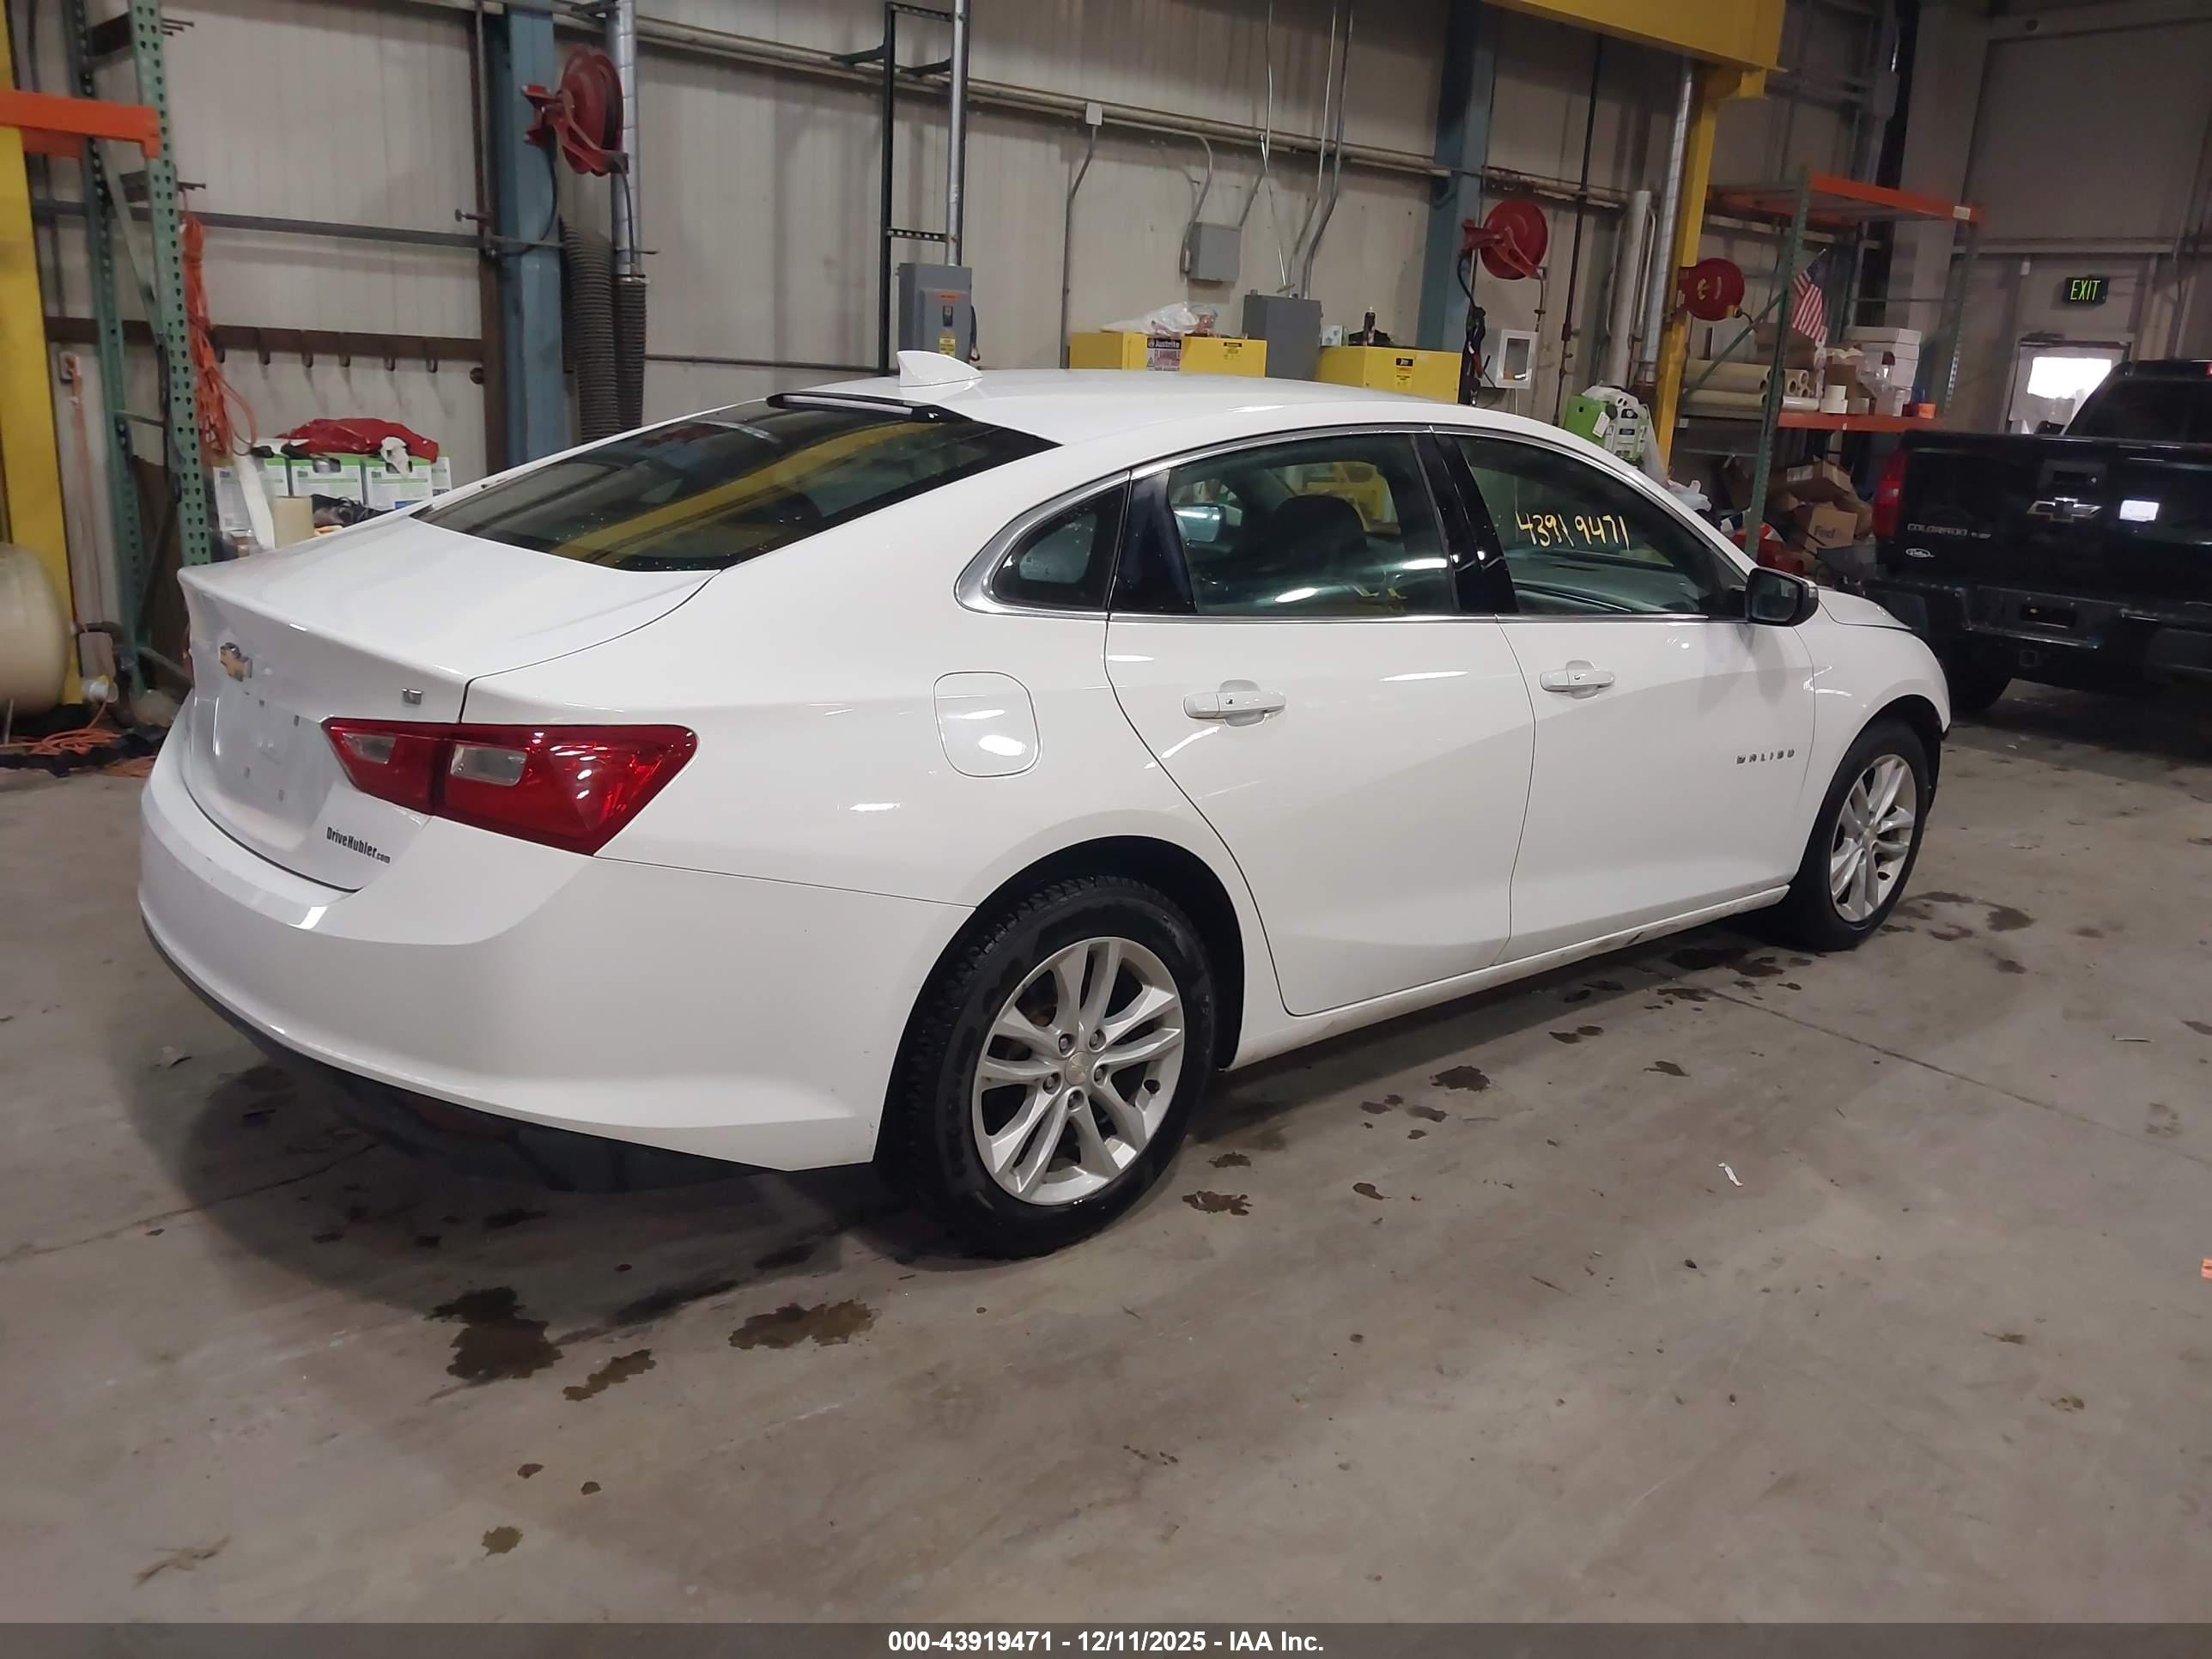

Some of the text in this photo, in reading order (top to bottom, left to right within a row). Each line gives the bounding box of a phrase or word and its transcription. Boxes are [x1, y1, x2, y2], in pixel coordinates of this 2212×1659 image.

[2070, 280, 2101, 301] EXIT
[1515, 510, 1630, 551] 4391 9471
[1907, 523, 1968, 537] COLORADO
[1736, 749, 1796, 765] MALIBU
